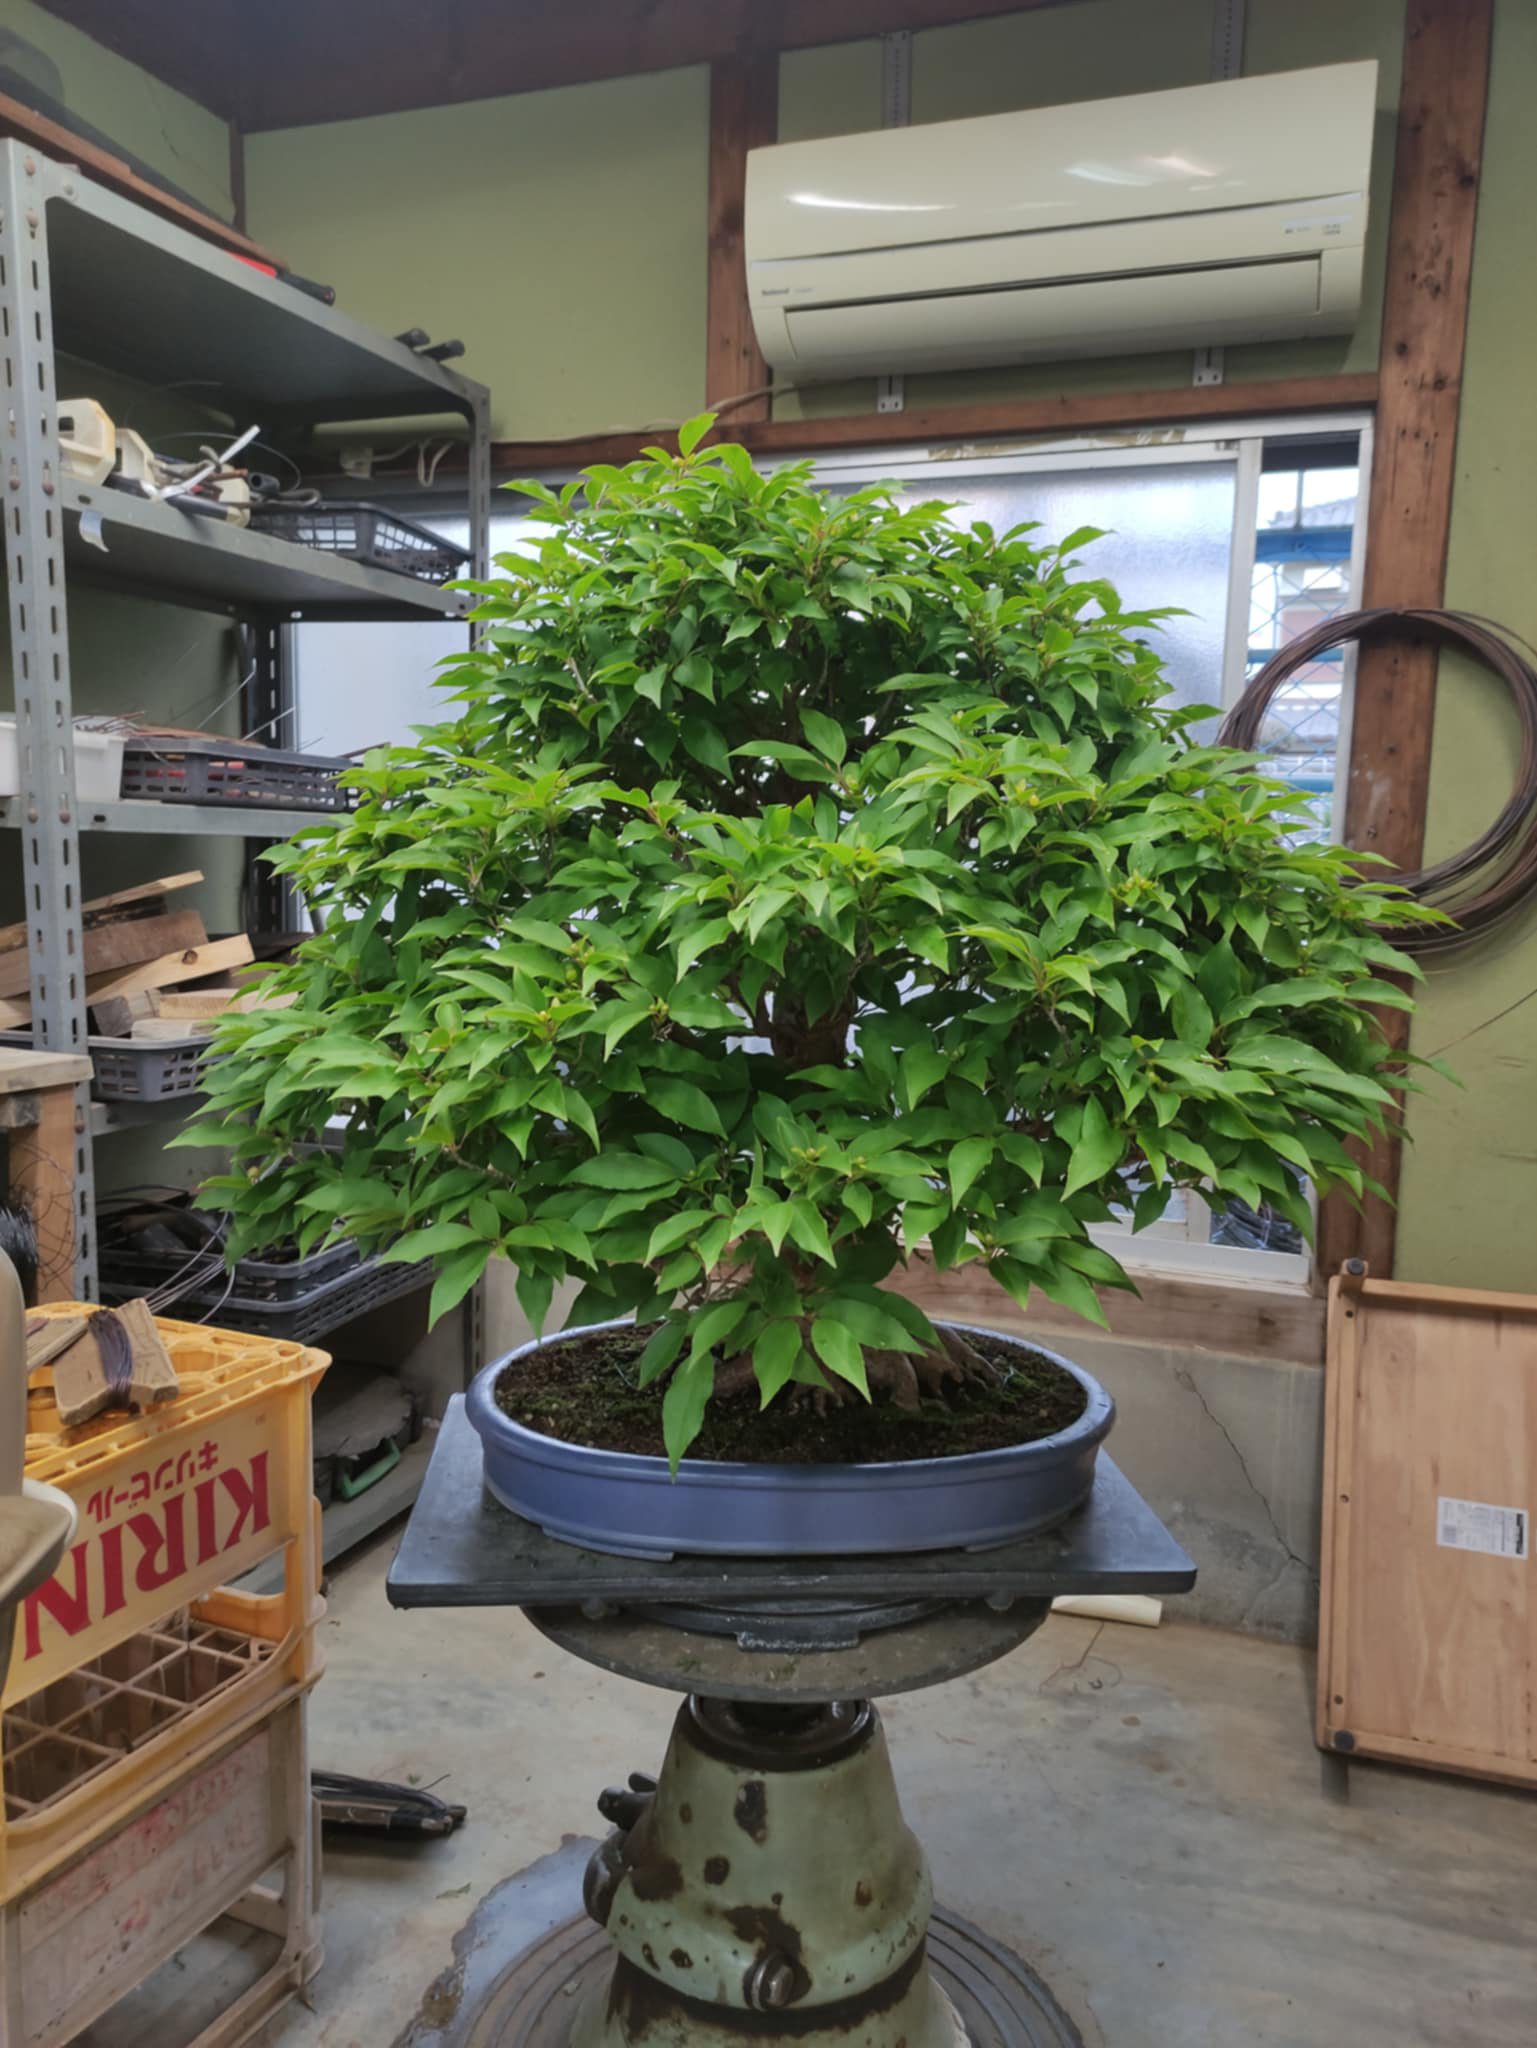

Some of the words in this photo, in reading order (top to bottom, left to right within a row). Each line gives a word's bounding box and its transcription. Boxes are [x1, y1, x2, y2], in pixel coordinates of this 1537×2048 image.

[23, 1450, 271, 1662] KIRIN
[86, 1440, 219, 1524] キリンビール
